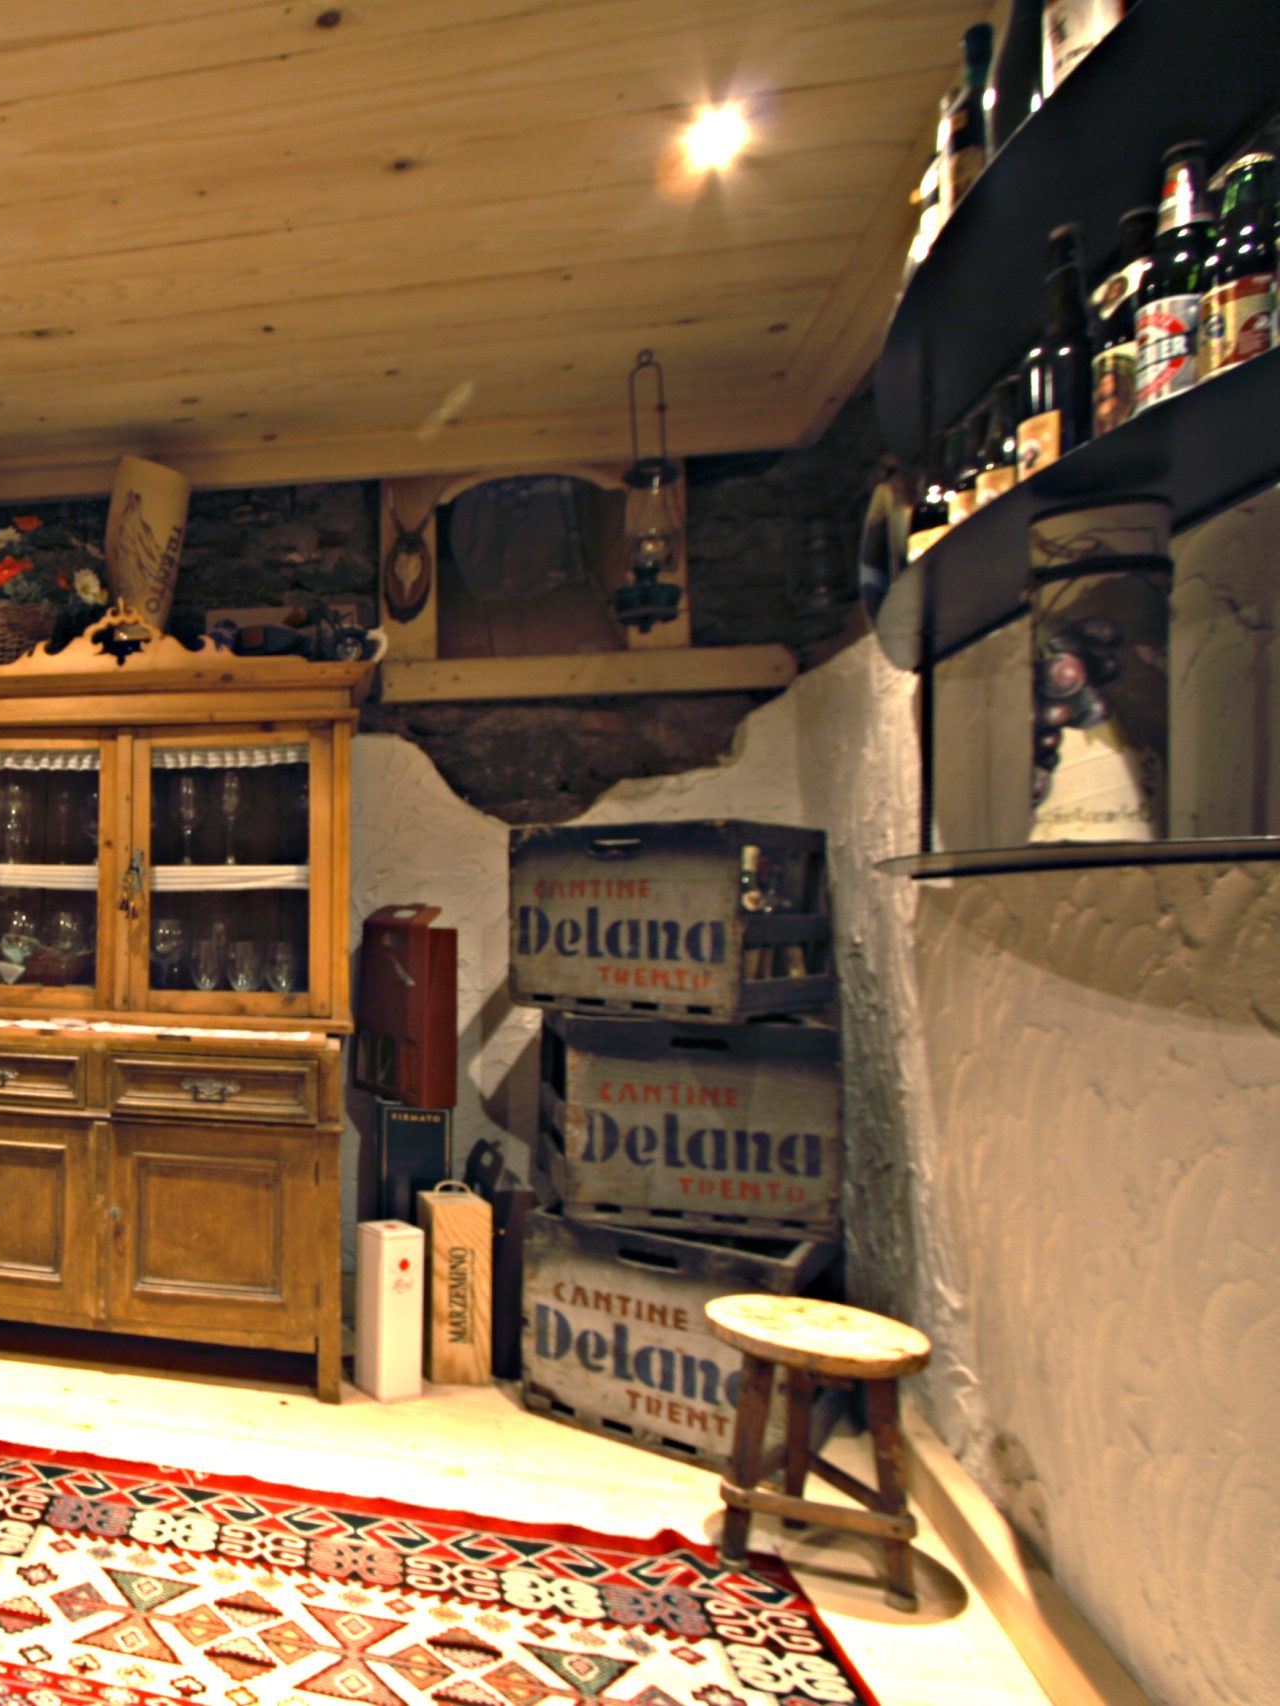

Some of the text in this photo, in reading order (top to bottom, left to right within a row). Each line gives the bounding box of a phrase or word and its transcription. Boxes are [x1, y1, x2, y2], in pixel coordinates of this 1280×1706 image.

[534, 878, 652, 899] CANTINE
[518, 905, 725, 963] Delana
[599, 1081, 739, 1108] CANTINE
[390, 1112, 441, 1124] FIRMATO
[581, 1110, 822, 1178] Delana
[678, 1176, 806, 1203] TRENTO
[449, 1246, 468, 1343] MARZEMINO
[553, 1281, 689, 1331] CANTINE
[625, 1390, 729, 1436] TRENT
